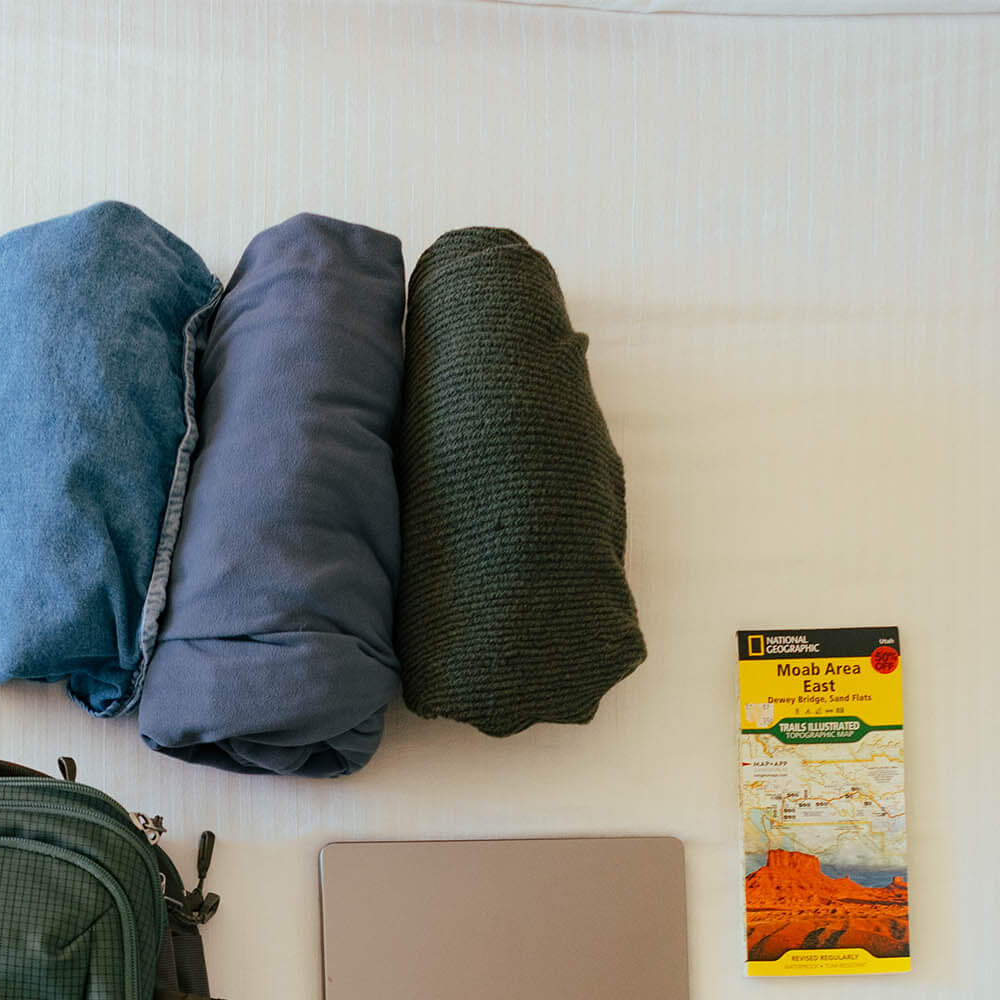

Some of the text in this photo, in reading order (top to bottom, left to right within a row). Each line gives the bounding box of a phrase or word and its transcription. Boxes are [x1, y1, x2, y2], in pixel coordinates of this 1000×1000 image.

[766, 635, 808, 645] NATIONAL
[766, 643, 820, 654] GEOGRAPHIC
[777, 662, 861, 677] Moab Area
[803, 680, 836, 693] East
[768, 696, 796, 705] Dewey
[829, 695, 850, 703] Sand
[852, 694, 872, 702] Flats
[779, 721, 860, 732] TRAILS ILLUSTRATED
